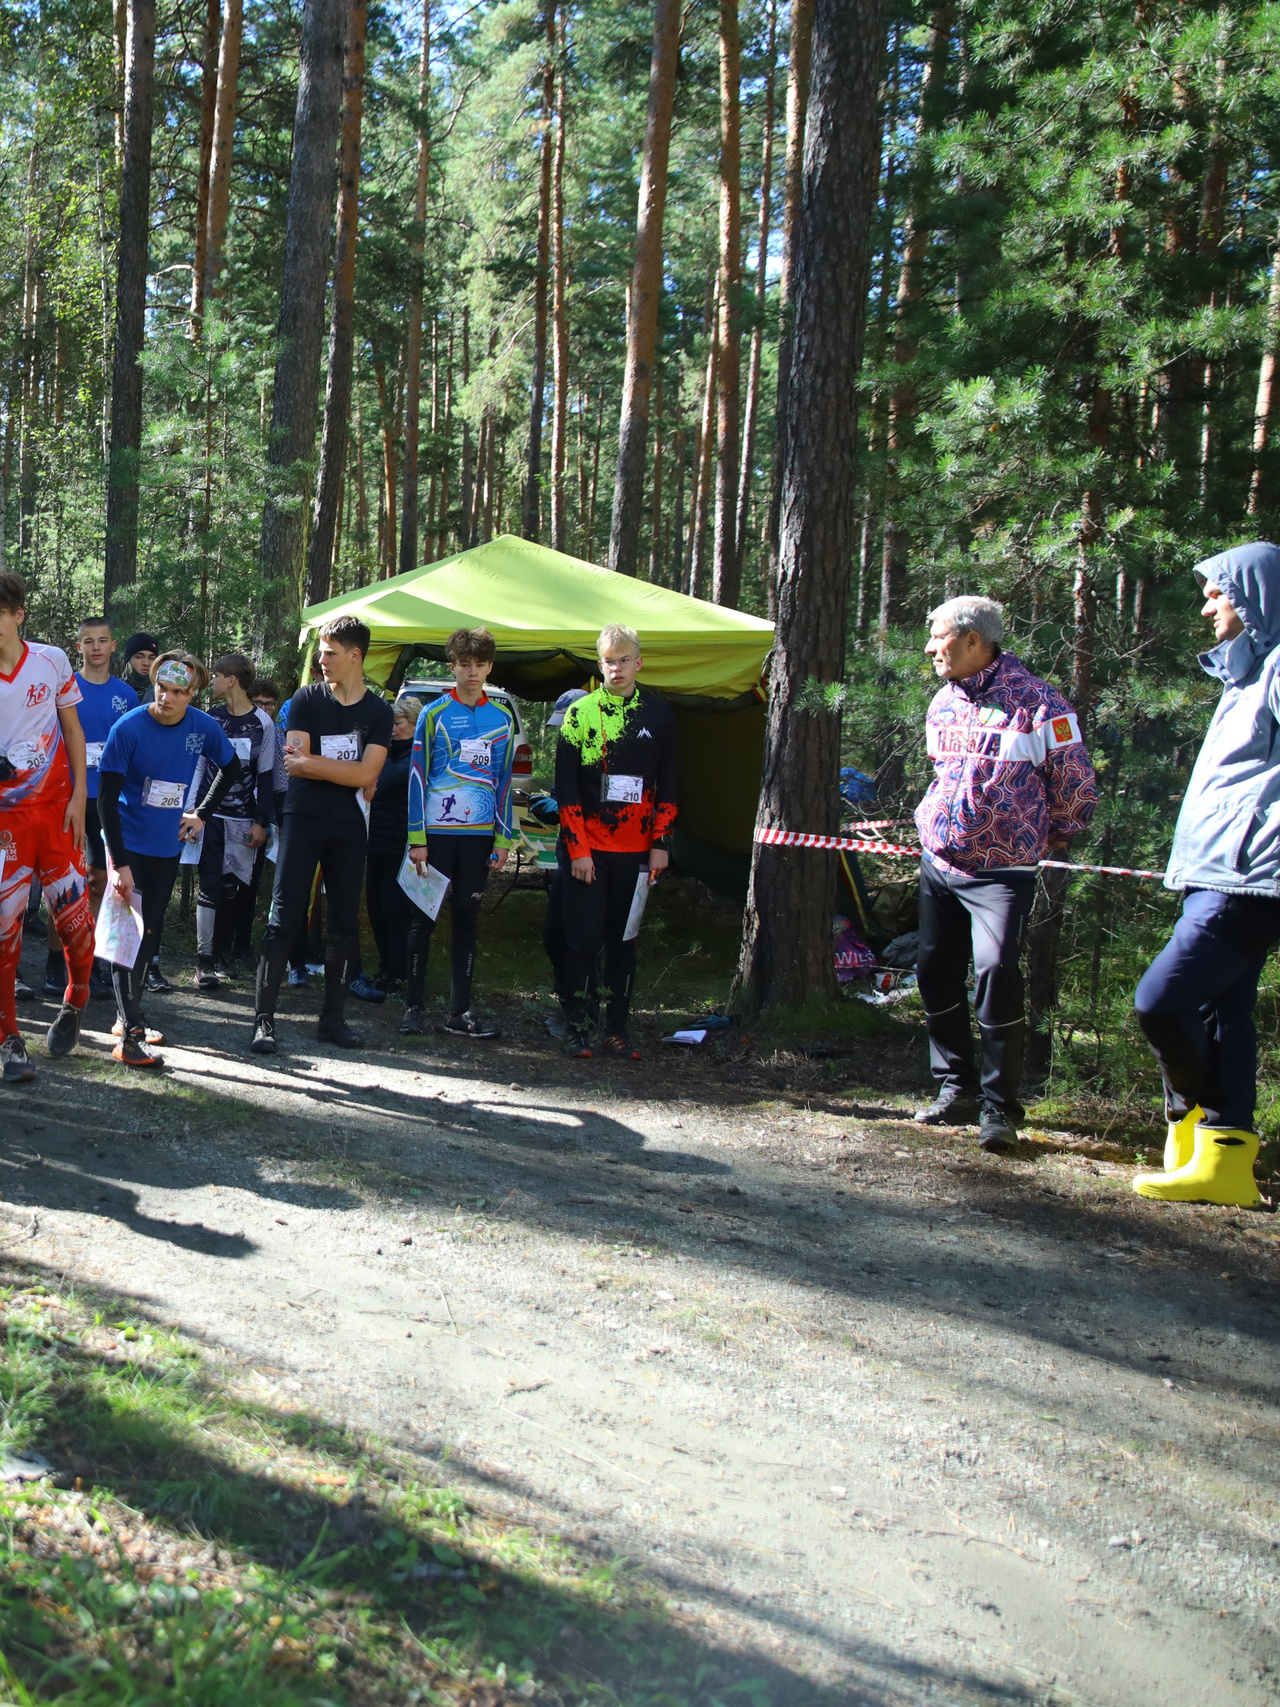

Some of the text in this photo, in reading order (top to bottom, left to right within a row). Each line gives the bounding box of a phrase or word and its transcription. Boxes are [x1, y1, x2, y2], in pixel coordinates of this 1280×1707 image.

[336, 749, 357, 761] 207
[471, 754, 490, 766] 209
[26, 753, 46, 770] 205
[160, 796, 180, 806] 206
[622, 791, 639, 802] 210
